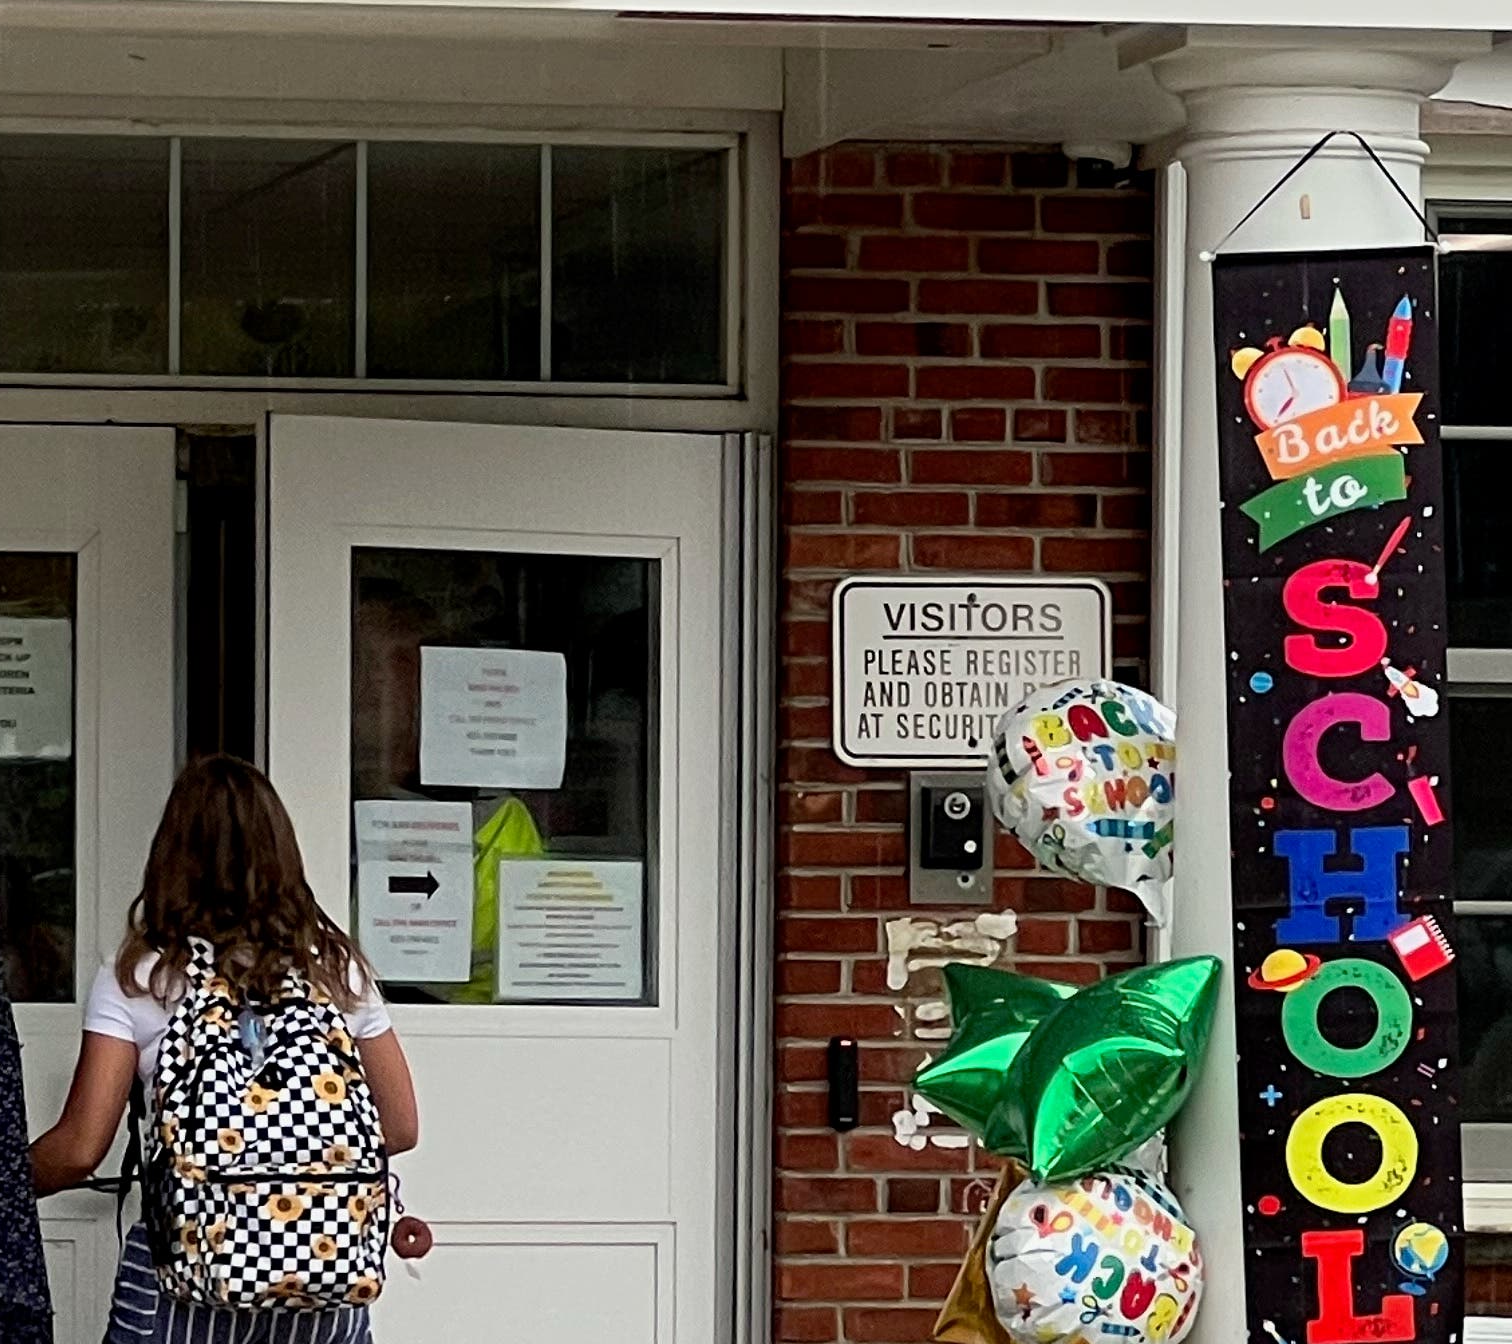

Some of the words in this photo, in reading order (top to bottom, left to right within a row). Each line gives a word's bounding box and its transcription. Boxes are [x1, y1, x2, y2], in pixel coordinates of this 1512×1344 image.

[1274, 399, 1400, 465] Back
[1302, 470, 1368, 518] to
[883, 602, 1063, 633] VISITORS
[863, 649, 952, 677] PLEASE
[966, 649, 1082, 677] REGISTER
[863, 681, 911, 708] AND
[924, 681, 1009, 708] OBTAIN
[857, 713, 883, 740] AT
[896, 714, 999, 741] SECURIT
[1031, 694, 1168, 748] BACK
[1092, 743, 1143, 771] TO
[1063, 773, 1175, 817] SCHOO
[1123, 1231, 1161, 1274] TO
